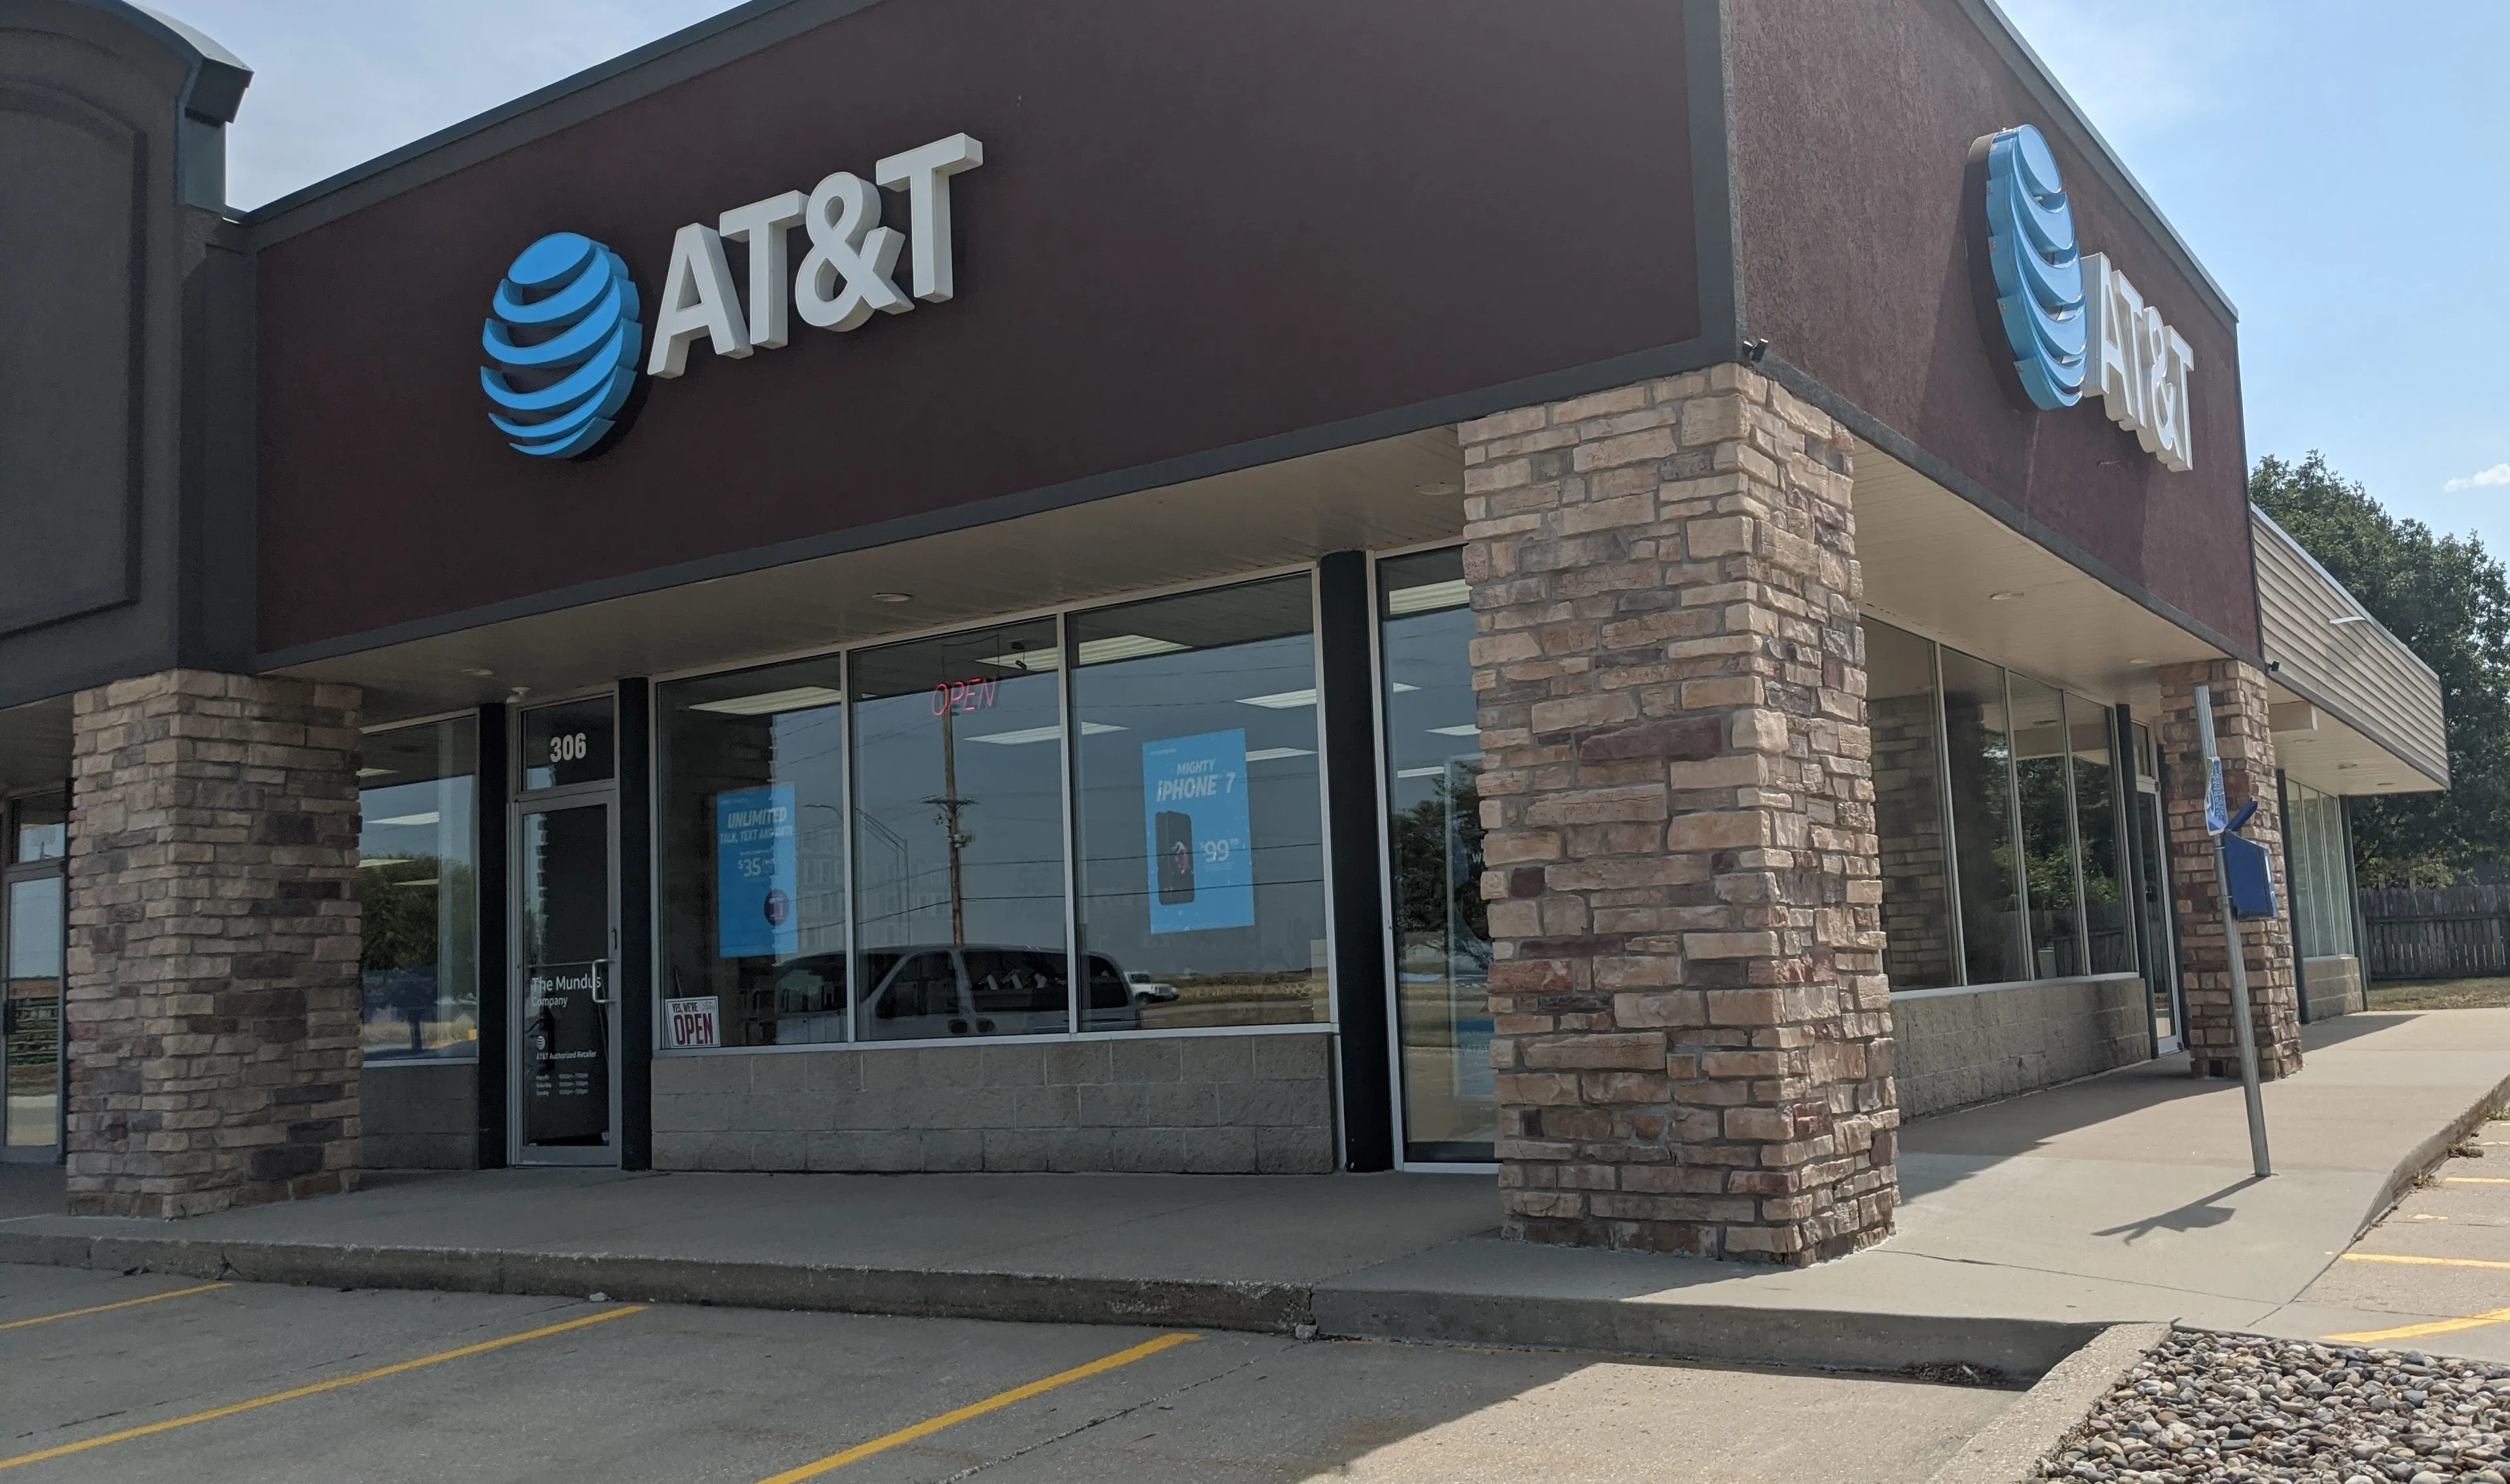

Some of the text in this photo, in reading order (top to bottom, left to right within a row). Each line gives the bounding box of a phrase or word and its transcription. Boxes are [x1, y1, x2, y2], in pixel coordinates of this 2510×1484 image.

[647, 132, 983, 379] AT&T
[2079, 251, 2194, 472] AT&T
[932, 676, 997, 715] OPEN
[550, 733, 587, 763] 306
[1177, 759, 1216, 775] MIGHTY
[1226, 772, 1237, 794] 7
[727, 806, 788, 829] UNLIMITED
[740, 829, 758, 842] TEXT
[532, 976, 553, 991] The
[532, 996, 568, 1008] Company
[674, 1013, 714, 1045] OPEN
